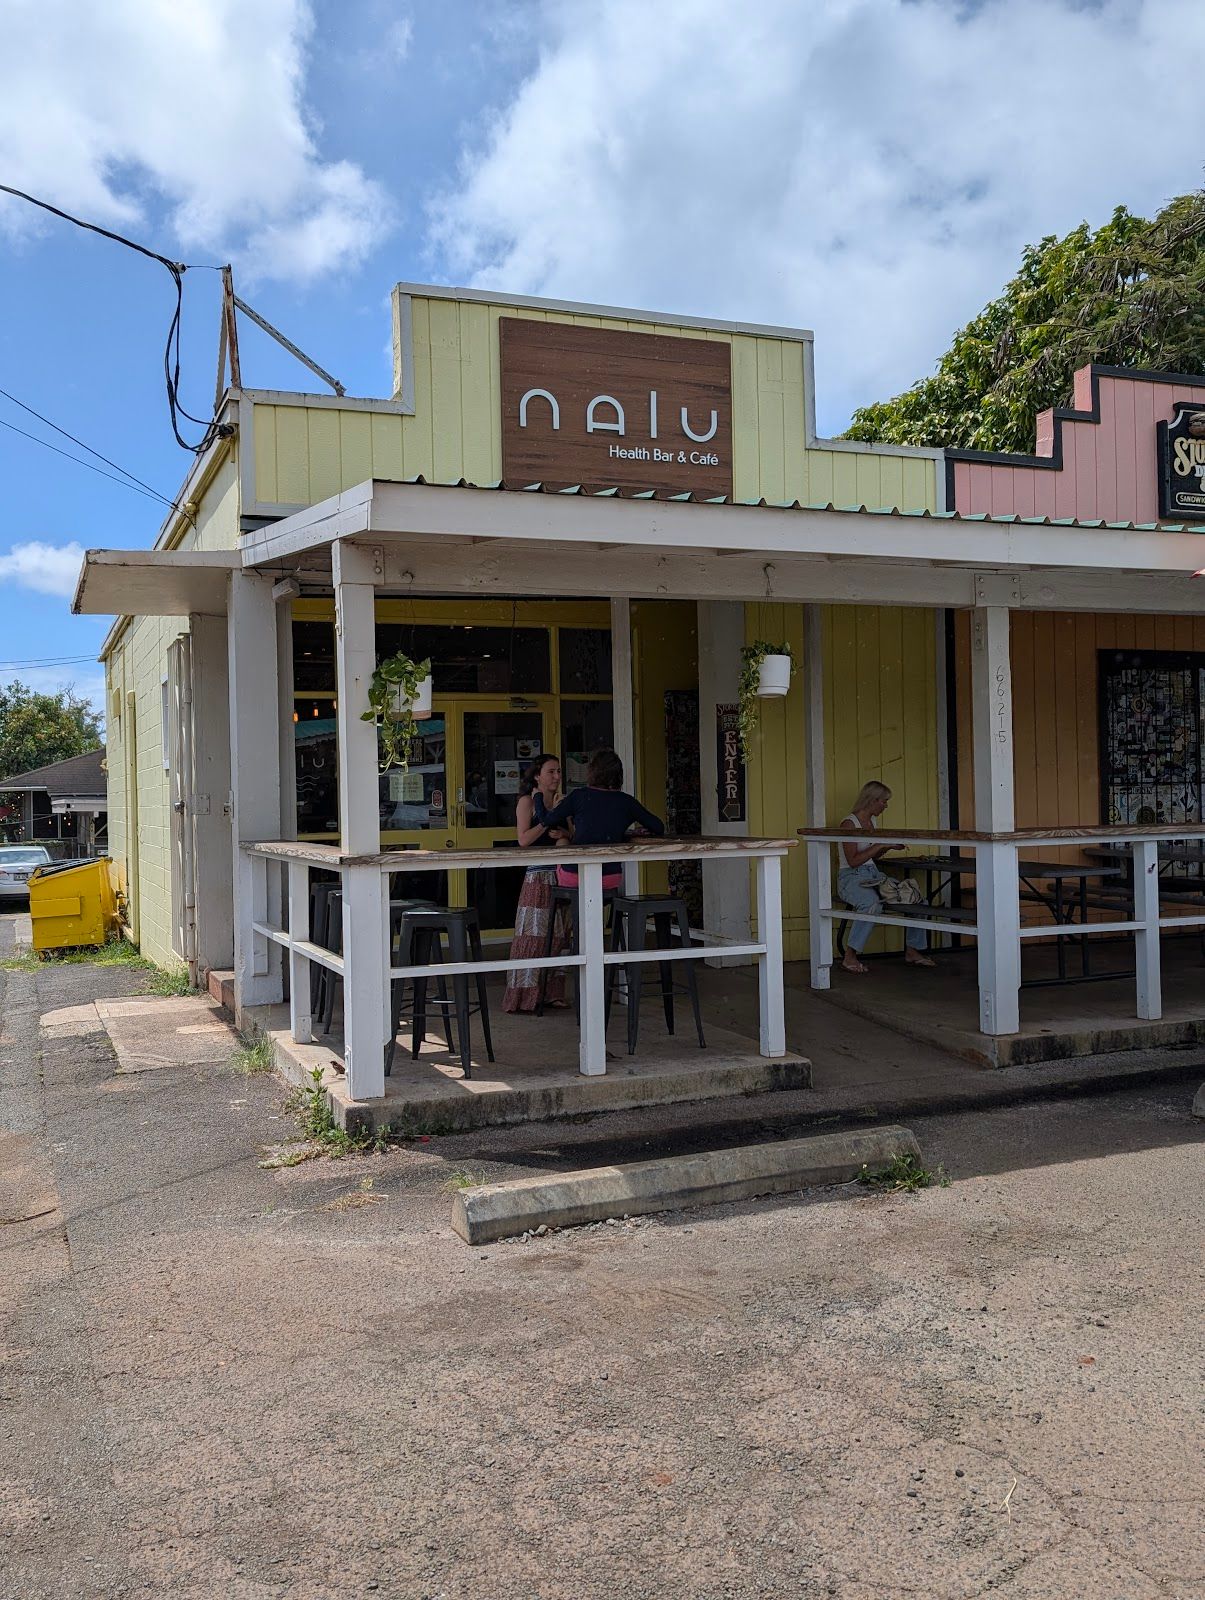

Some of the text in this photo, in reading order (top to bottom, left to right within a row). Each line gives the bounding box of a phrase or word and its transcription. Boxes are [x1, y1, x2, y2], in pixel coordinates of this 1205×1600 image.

[609, 445, 719, 466] Health Bar & Café
[724, 730, 738, 799] ENTER
